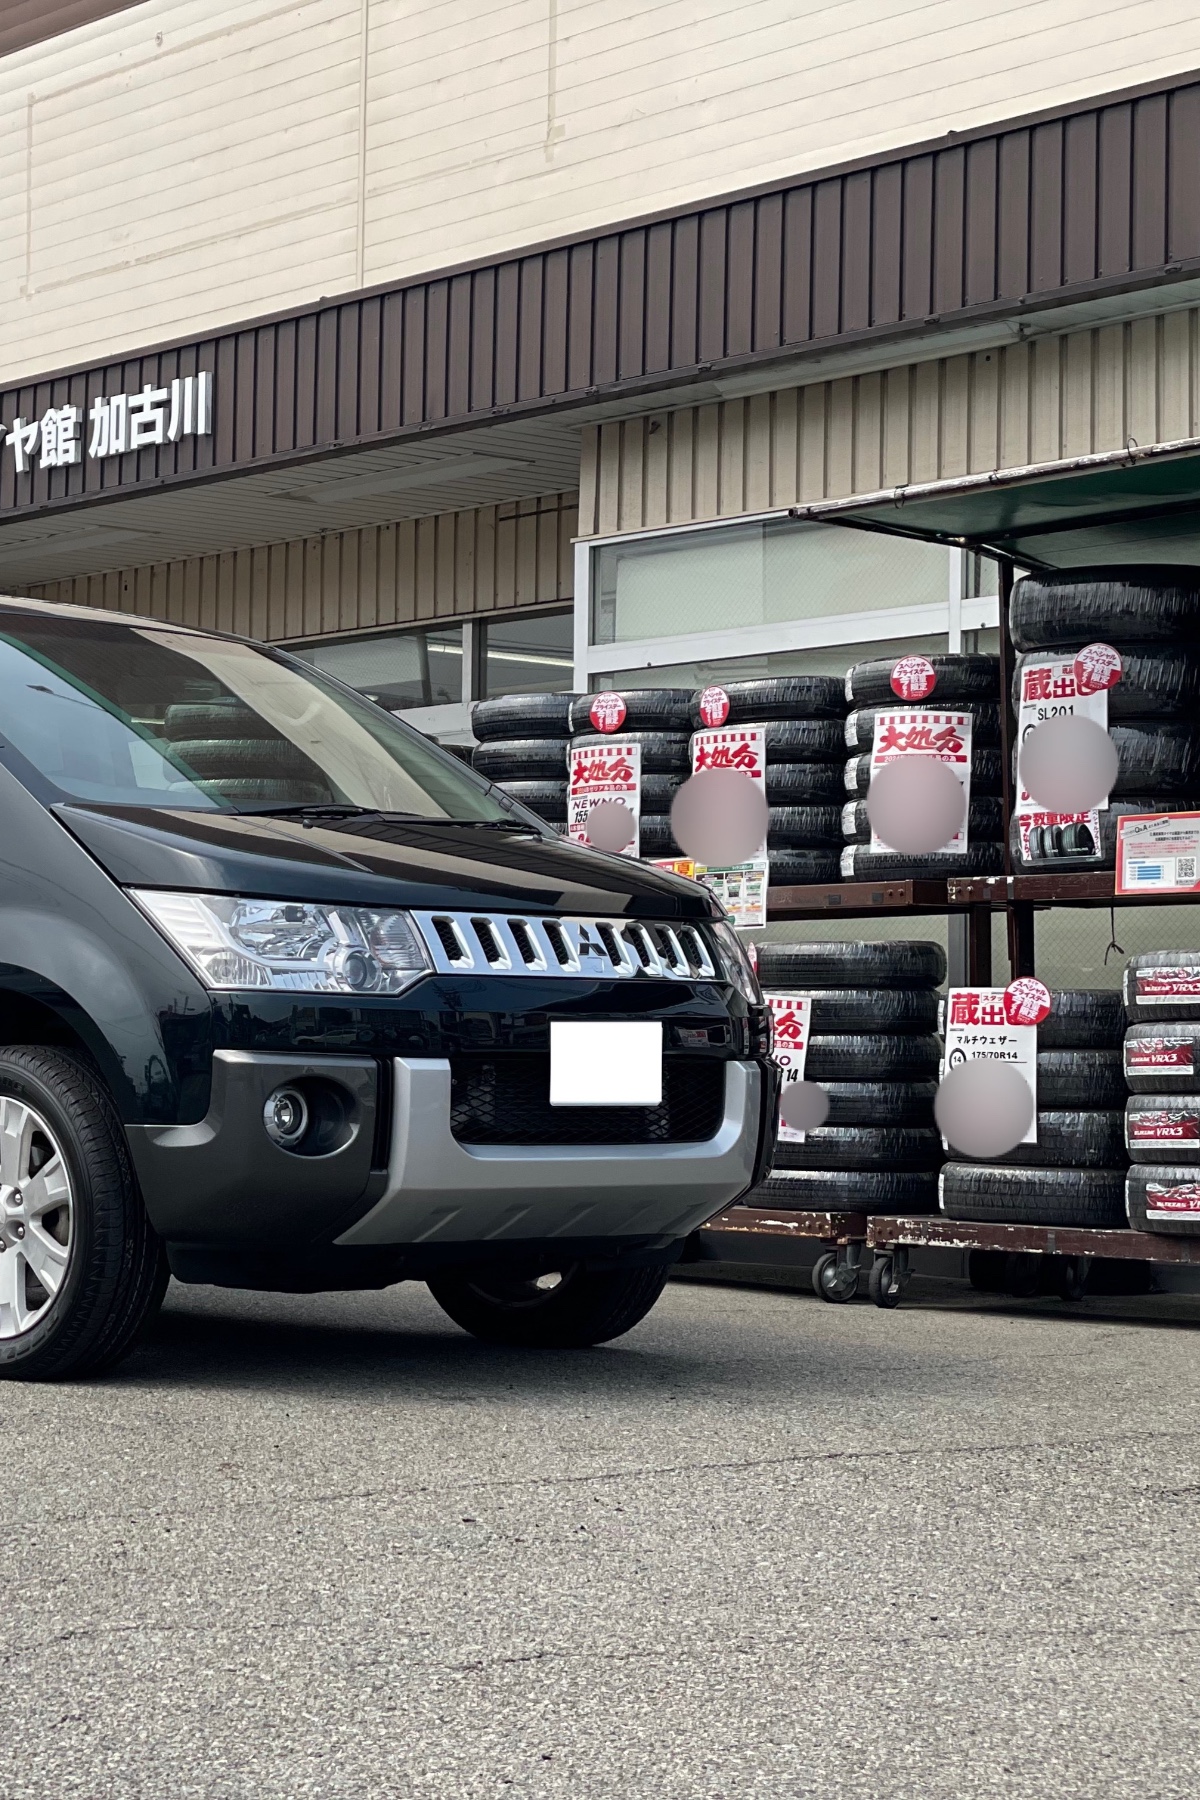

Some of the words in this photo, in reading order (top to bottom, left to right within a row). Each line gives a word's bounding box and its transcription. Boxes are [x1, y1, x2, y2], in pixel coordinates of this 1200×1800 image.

[89, 371, 212, 459] 加古川
[1083, 655, 1118, 666] プライスデー
[1086, 649, 1117, 660] スペシャル
[897, 668, 930, 676] プライスデー
[1023, 667, 1098, 703] 蔵出し
[1038, 705, 1074, 720] SL201
[877, 725, 965, 754] 大処分
[695, 742, 759, 773] 大処分
[572, 757, 634, 786] 大処分
[1013, 986, 1046, 1003] プライスデー
[1016, 981, 1047, 996] スペシャル
[956, 1036, 1018, 1045] マルチウェザー
[972, 1051, 1018, 1060] 175/70R14
[1151, 1053, 1177, 1063] VRX3
[1156, 1127, 1183, 1136] VRX3
